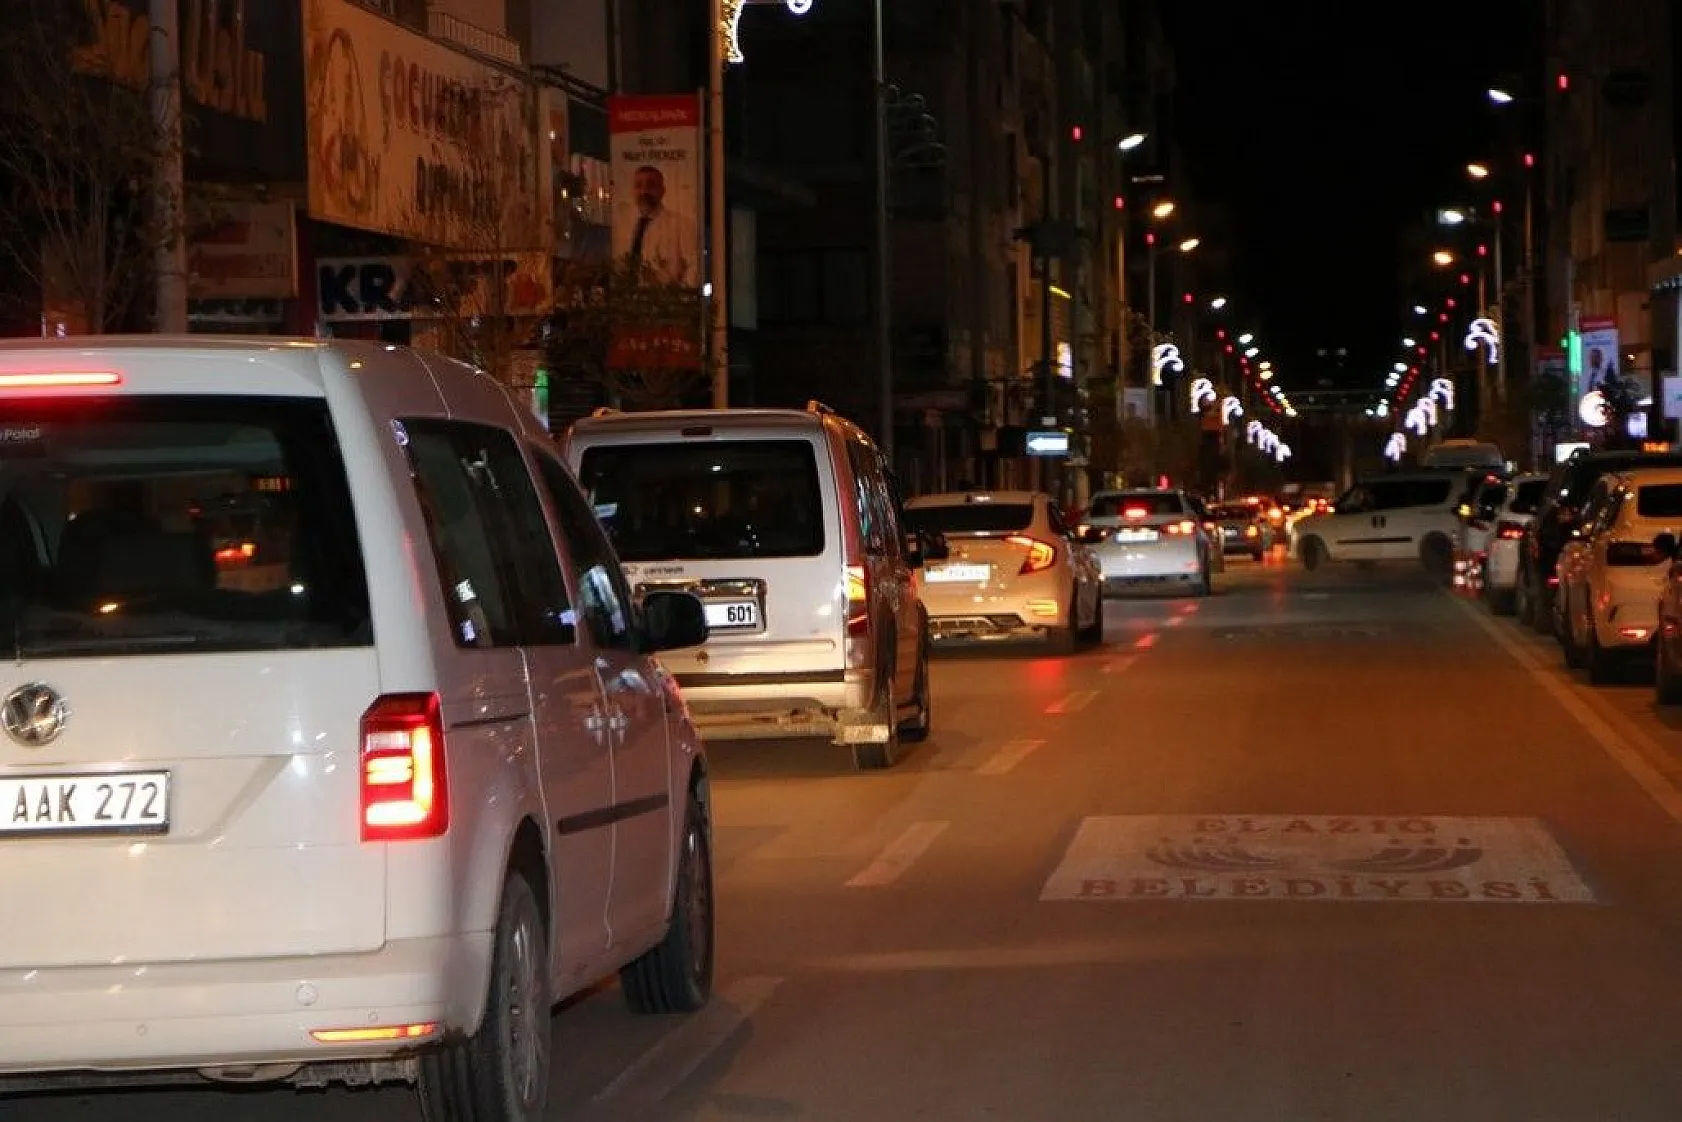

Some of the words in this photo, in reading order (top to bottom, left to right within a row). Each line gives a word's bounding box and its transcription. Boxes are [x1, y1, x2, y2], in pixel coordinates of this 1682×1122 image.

[727, 605, 752, 623] 601
[12, 784, 77, 822] AAK
[94, 781, 158, 820] 272
[1074, 876, 1560, 900] BELEDİYESİ
